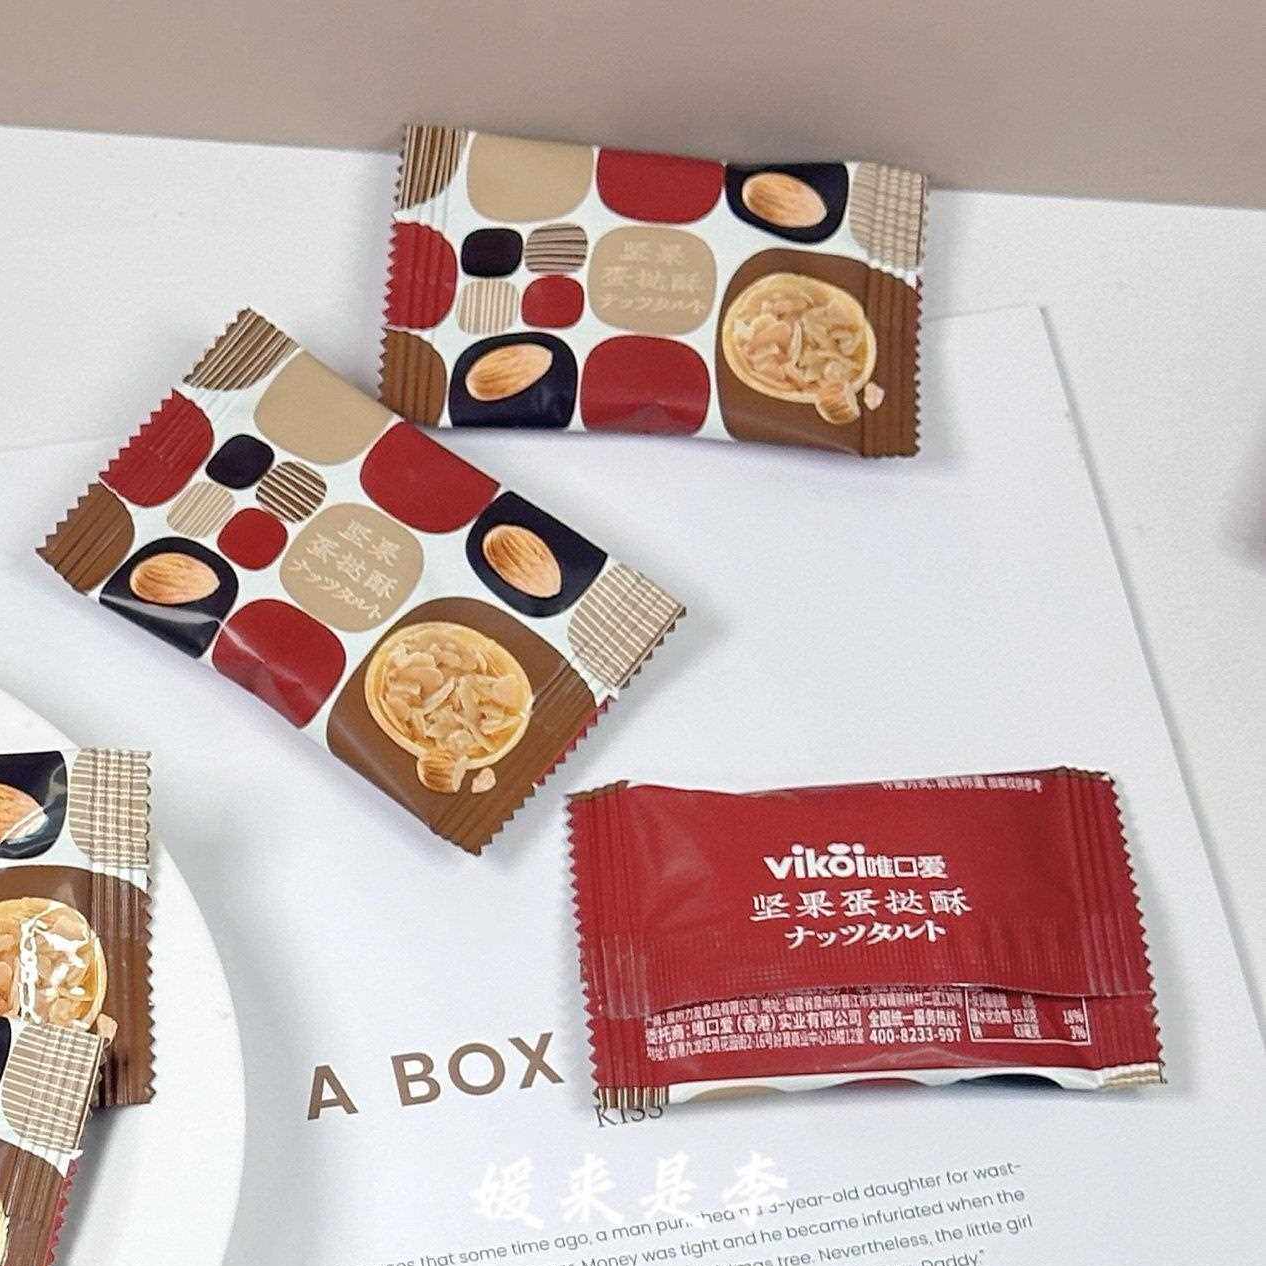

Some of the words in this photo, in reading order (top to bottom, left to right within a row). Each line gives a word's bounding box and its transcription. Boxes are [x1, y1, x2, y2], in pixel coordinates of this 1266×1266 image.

[339, 519, 401, 566] 坚果
[750, 887, 972, 921] 坚果蛋挞酥
[785, 919, 946, 950] ナッツタルト
[307, 1064, 358, 1121] A
[390, 1032, 565, 1107] BOX
[459, 1245, 508, 1264] some
[511, 1238, 550, 1256] time
[596, 1231, 608, 1242] a
[612, 1222, 652, 1240] man
[864, 1173, 942, 1198] daughter
[946, 1169, 970, 1185] for
[973, 1161, 1022, 1181] wast-
[642, 1246, 677, 1263] was
[681, 1238, 720, 1259] tight
[723, 1230, 758, 1249] and
[761, 1227, 782, 1244] he
[786, 1215, 859, 1240] became
[862, 1200, 944, 1227] infuriated
[947, 1193, 994, 1213] when
[997, 1189, 1025, 1205] the
[819, 1232, 933, 1262] Nevertheless,
[935, 1228, 963, 1244] the
[966, 1219, 1002, 1237] little
[1006, 1213, 1033, 1235] girl
